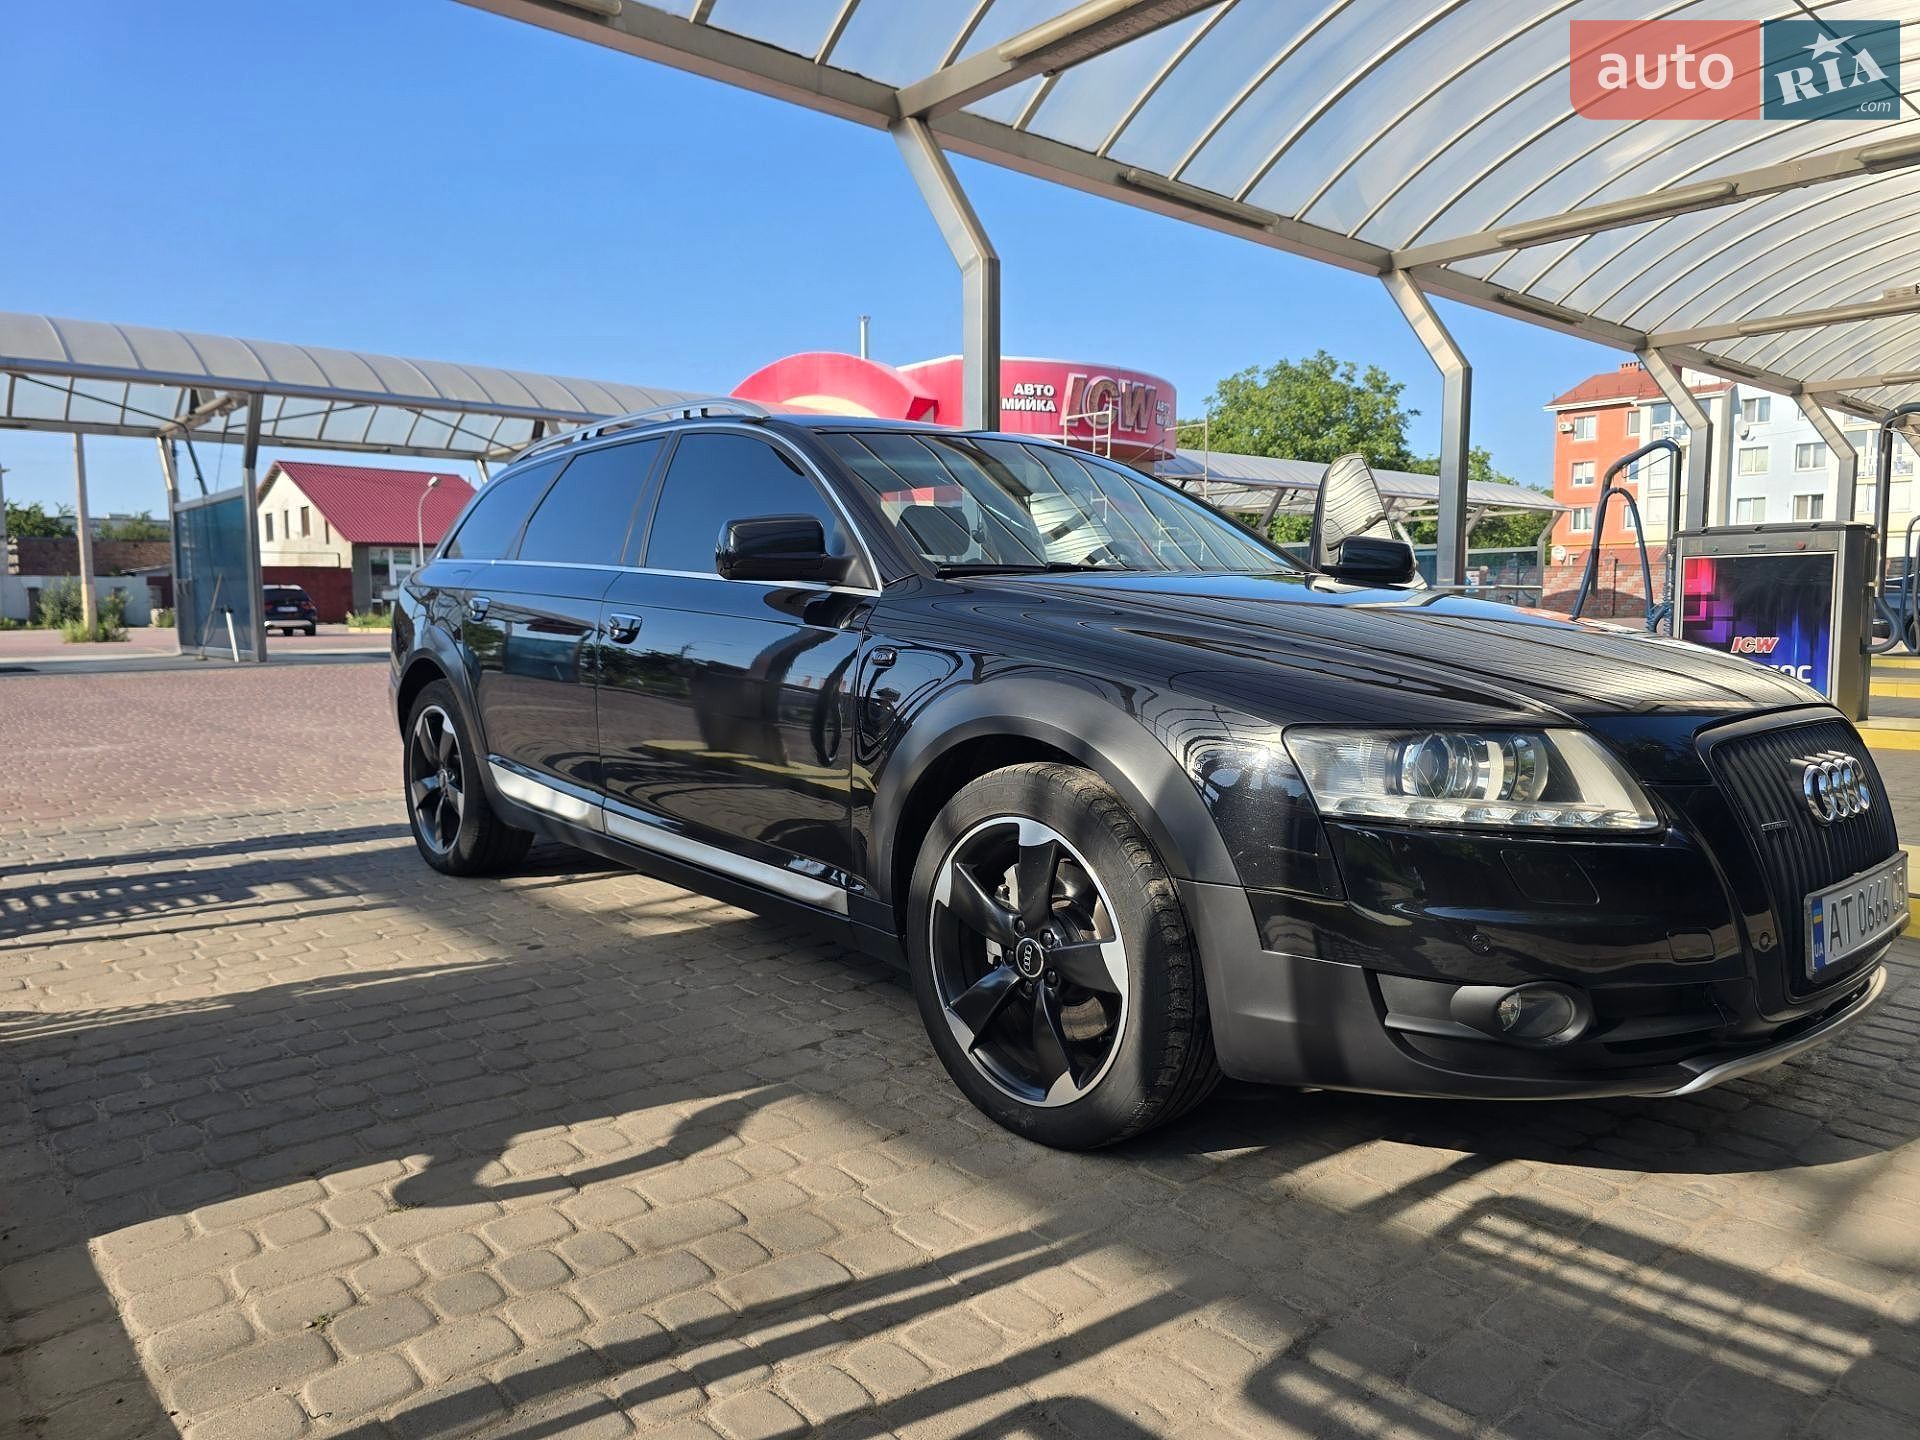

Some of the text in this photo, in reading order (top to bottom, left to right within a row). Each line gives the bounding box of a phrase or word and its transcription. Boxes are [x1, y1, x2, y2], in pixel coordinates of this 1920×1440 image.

[1013, 383, 1056, 397] АВТО
[1001, 397, 1057, 412] МИЙКА
[1814, 941, 1825, 958] UA
